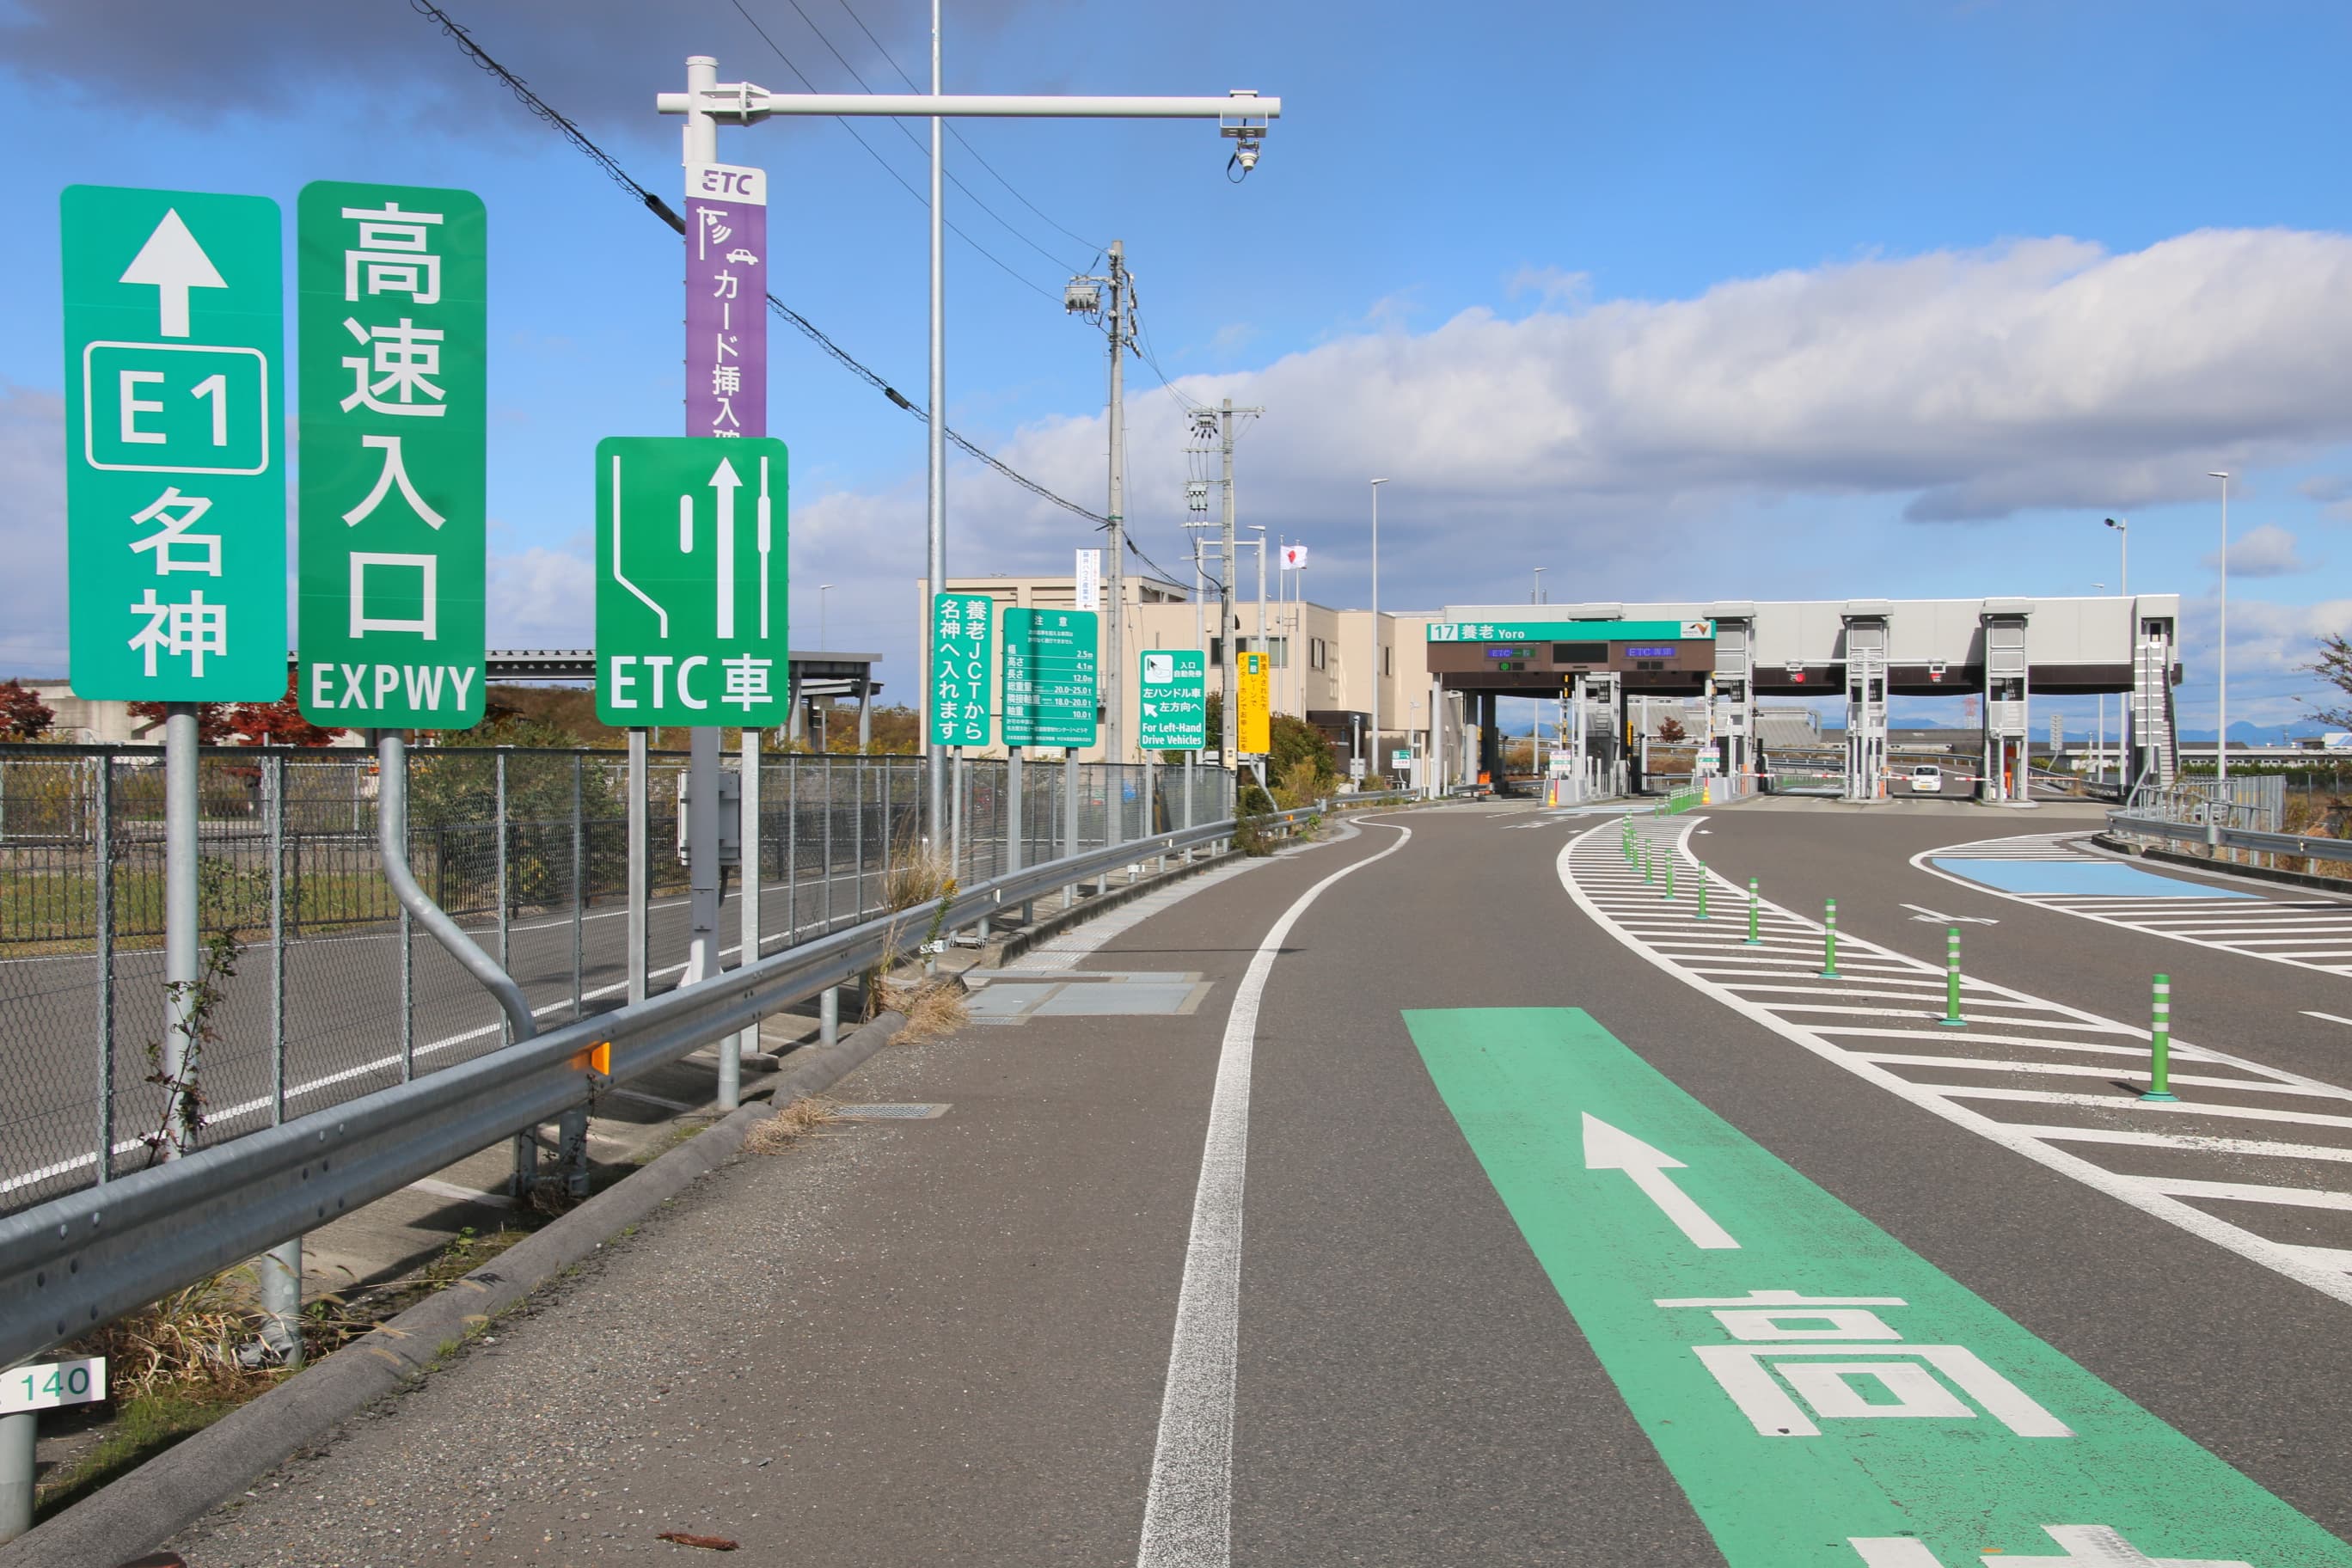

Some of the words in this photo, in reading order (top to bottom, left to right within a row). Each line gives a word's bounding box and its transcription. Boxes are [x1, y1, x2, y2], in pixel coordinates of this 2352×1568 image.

[702, 168, 753, 195] ETC
[119, 370, 229, 447] E1
[340, 202, 447, 640] 高速入口
[128, 487, 227, 677] 名神
[1435, 625, 1454, 639] 17
[1462, 624, 1494, 639] 養老
[1498, 629, 1525, 639] Yoro
[1008, 657, 1024, 666] 高さ
[1629, 647, 1651, 657] ETC
[939, 599, 961, 739] 名神へ入れます
[964, 600, 987, 740] 養老JCTから
[1008, 669, 1024, 679] 長さ
[312, 663, 476, 711] EXPWY
[1142, 688, 1201, 699] 左ハンドル車
[1160, 701, 1202, 713] 左方向へ
[1142, 723, 1157, 732] For
[1159, 723, 1202, 733] Left-Hand
[1142, 735, 1165, 744] Drive
[1167, 735, 1202, 744] Vehicles
[21, 1367, 90, 1401] 140
